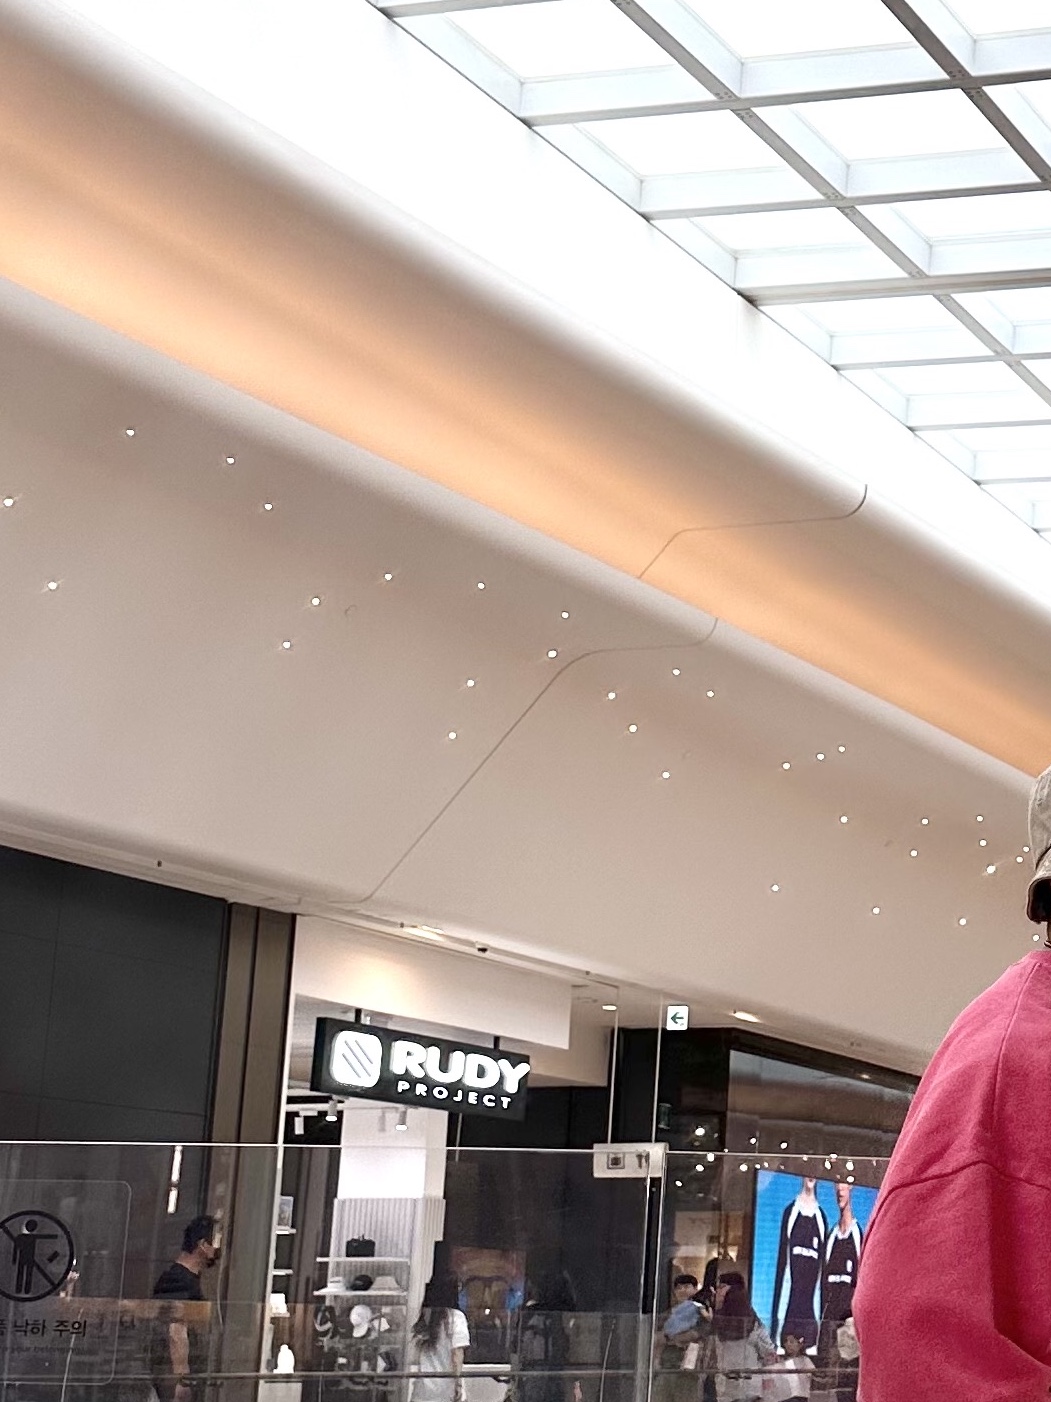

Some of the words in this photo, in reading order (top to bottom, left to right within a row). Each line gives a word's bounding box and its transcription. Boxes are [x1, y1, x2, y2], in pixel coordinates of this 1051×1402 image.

[391, 1040, 531, 1094] RUDY
[397, 1080, 511, 1109] PROJECT
[14, 1318, 46, 1337] 낙하
[53, 1319, 87, 1337] 주의
